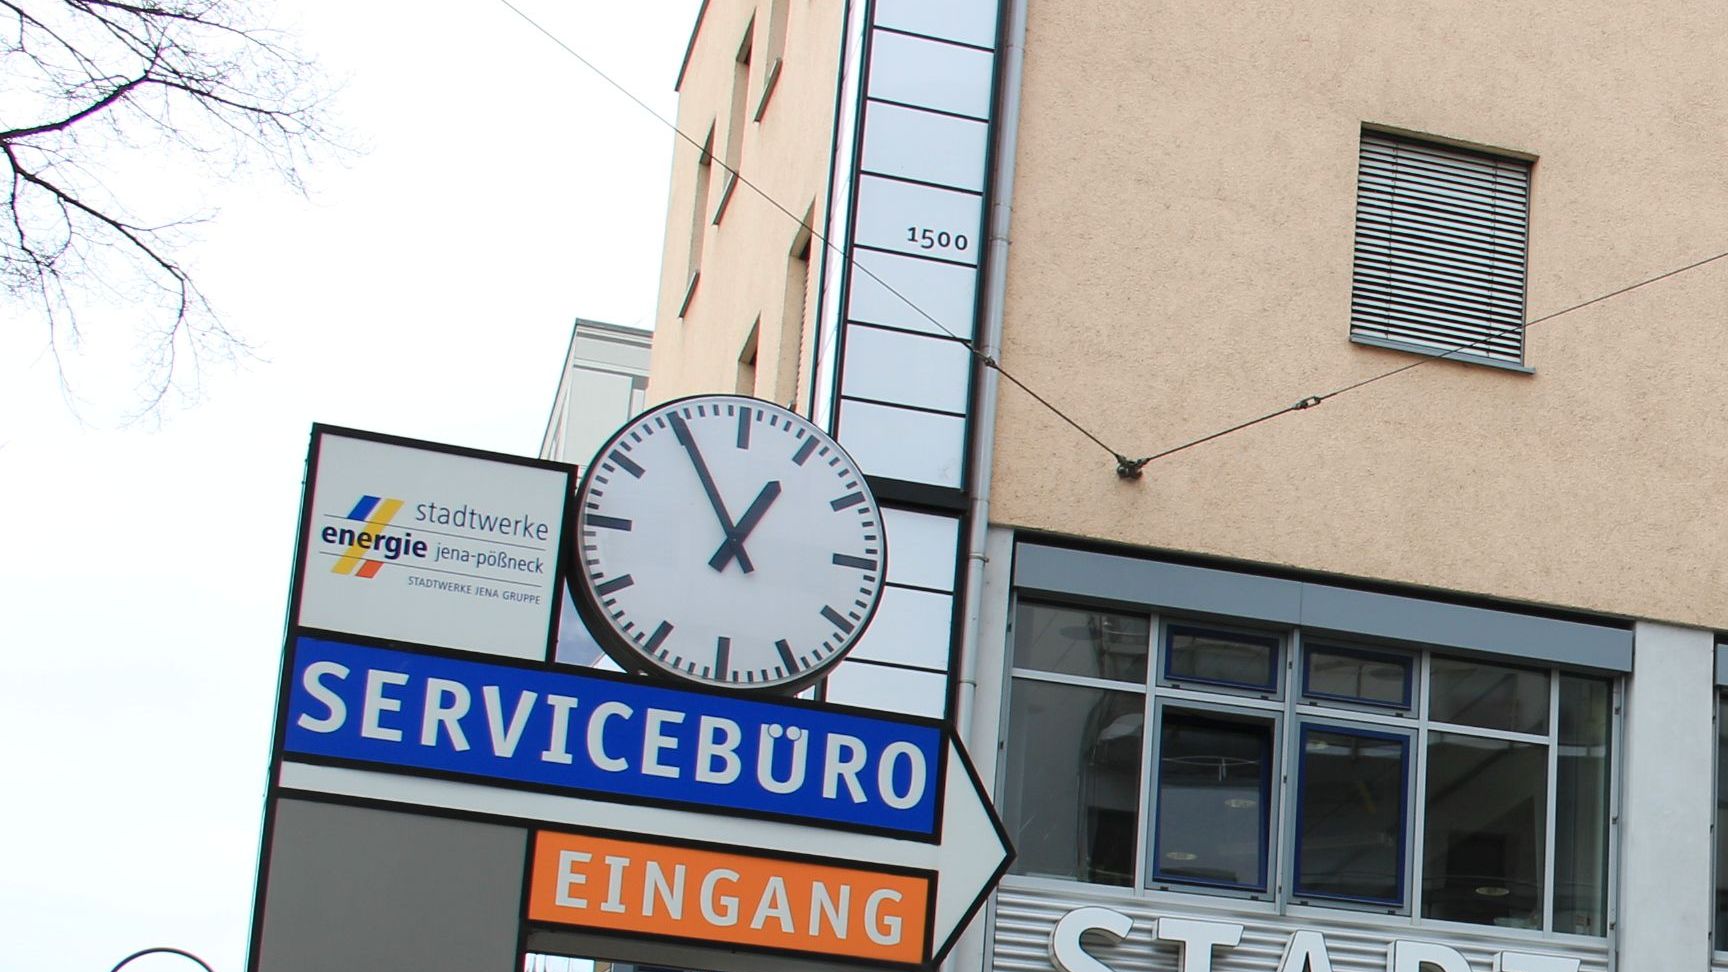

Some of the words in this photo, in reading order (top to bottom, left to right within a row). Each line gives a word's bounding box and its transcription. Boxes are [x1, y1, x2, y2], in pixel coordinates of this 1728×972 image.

[907, 226, 968, 250] 1500
[415, 502, 549, 541] stadtwerke
[321, 525, 428, 560] energie
[434, 543, 544, 574] jena-pößneck
[408, 575, 471, 595] STADTWERKE
[475, 585, 499, 598] JENA
[502, 590, 541, 605] GRUPPE
[297, 660, 927, 810] SERVICEBÜRO
[554, 849, 904, 947] EINGANG
